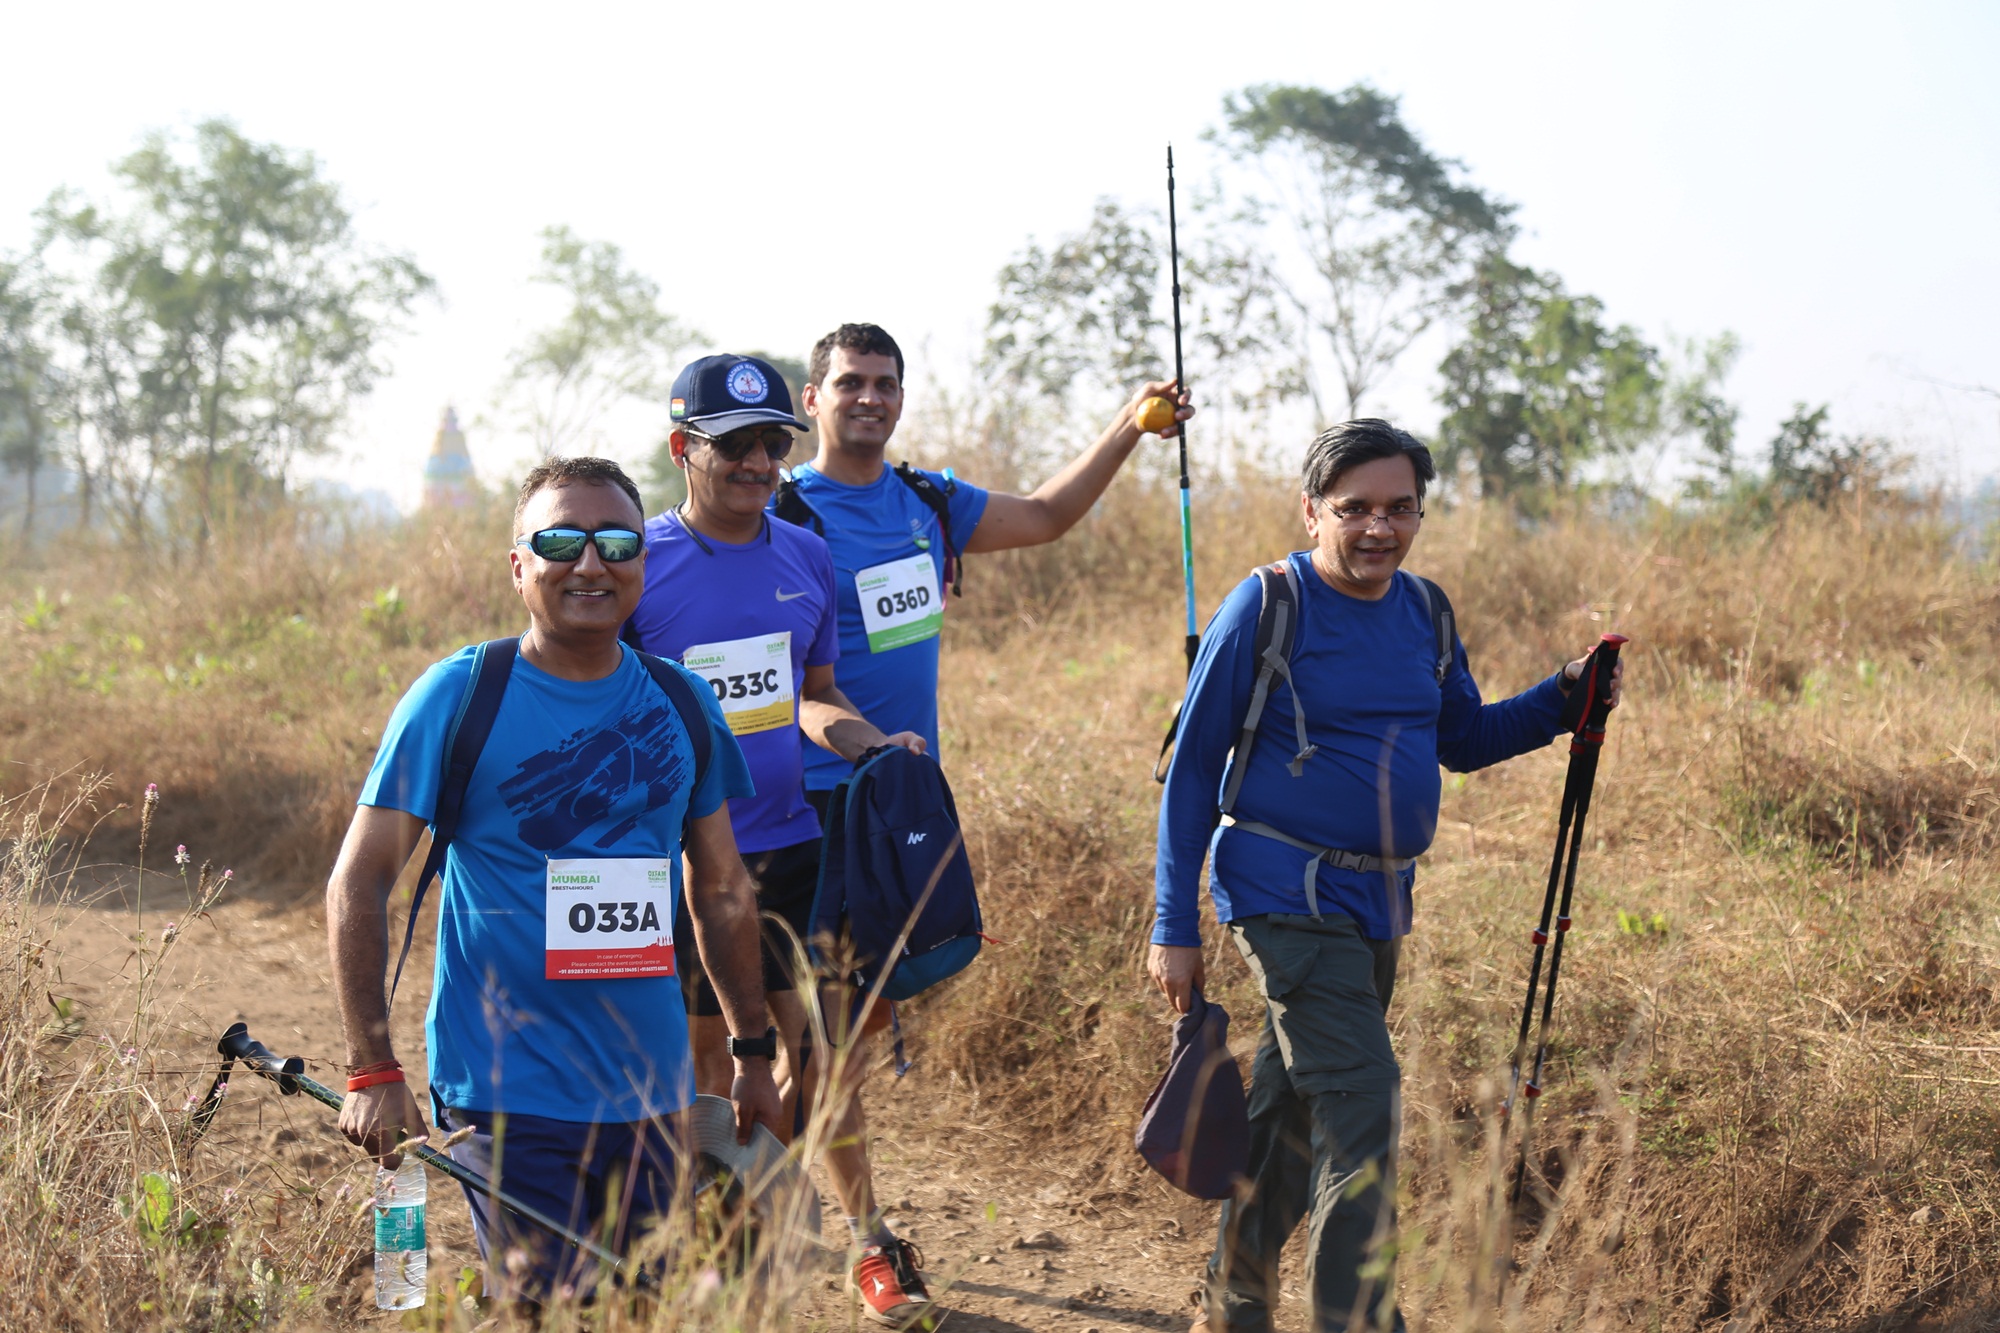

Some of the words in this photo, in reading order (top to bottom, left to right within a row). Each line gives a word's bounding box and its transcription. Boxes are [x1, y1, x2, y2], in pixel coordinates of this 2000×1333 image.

[877, 586, 930, 618] 036D
[687, 655, 725, 666] MUMBAI
[708, 668, 779, 702] 033C
[551, 875, 601, 884] MUMBAI
[568, 901, 661, 934] 033A
